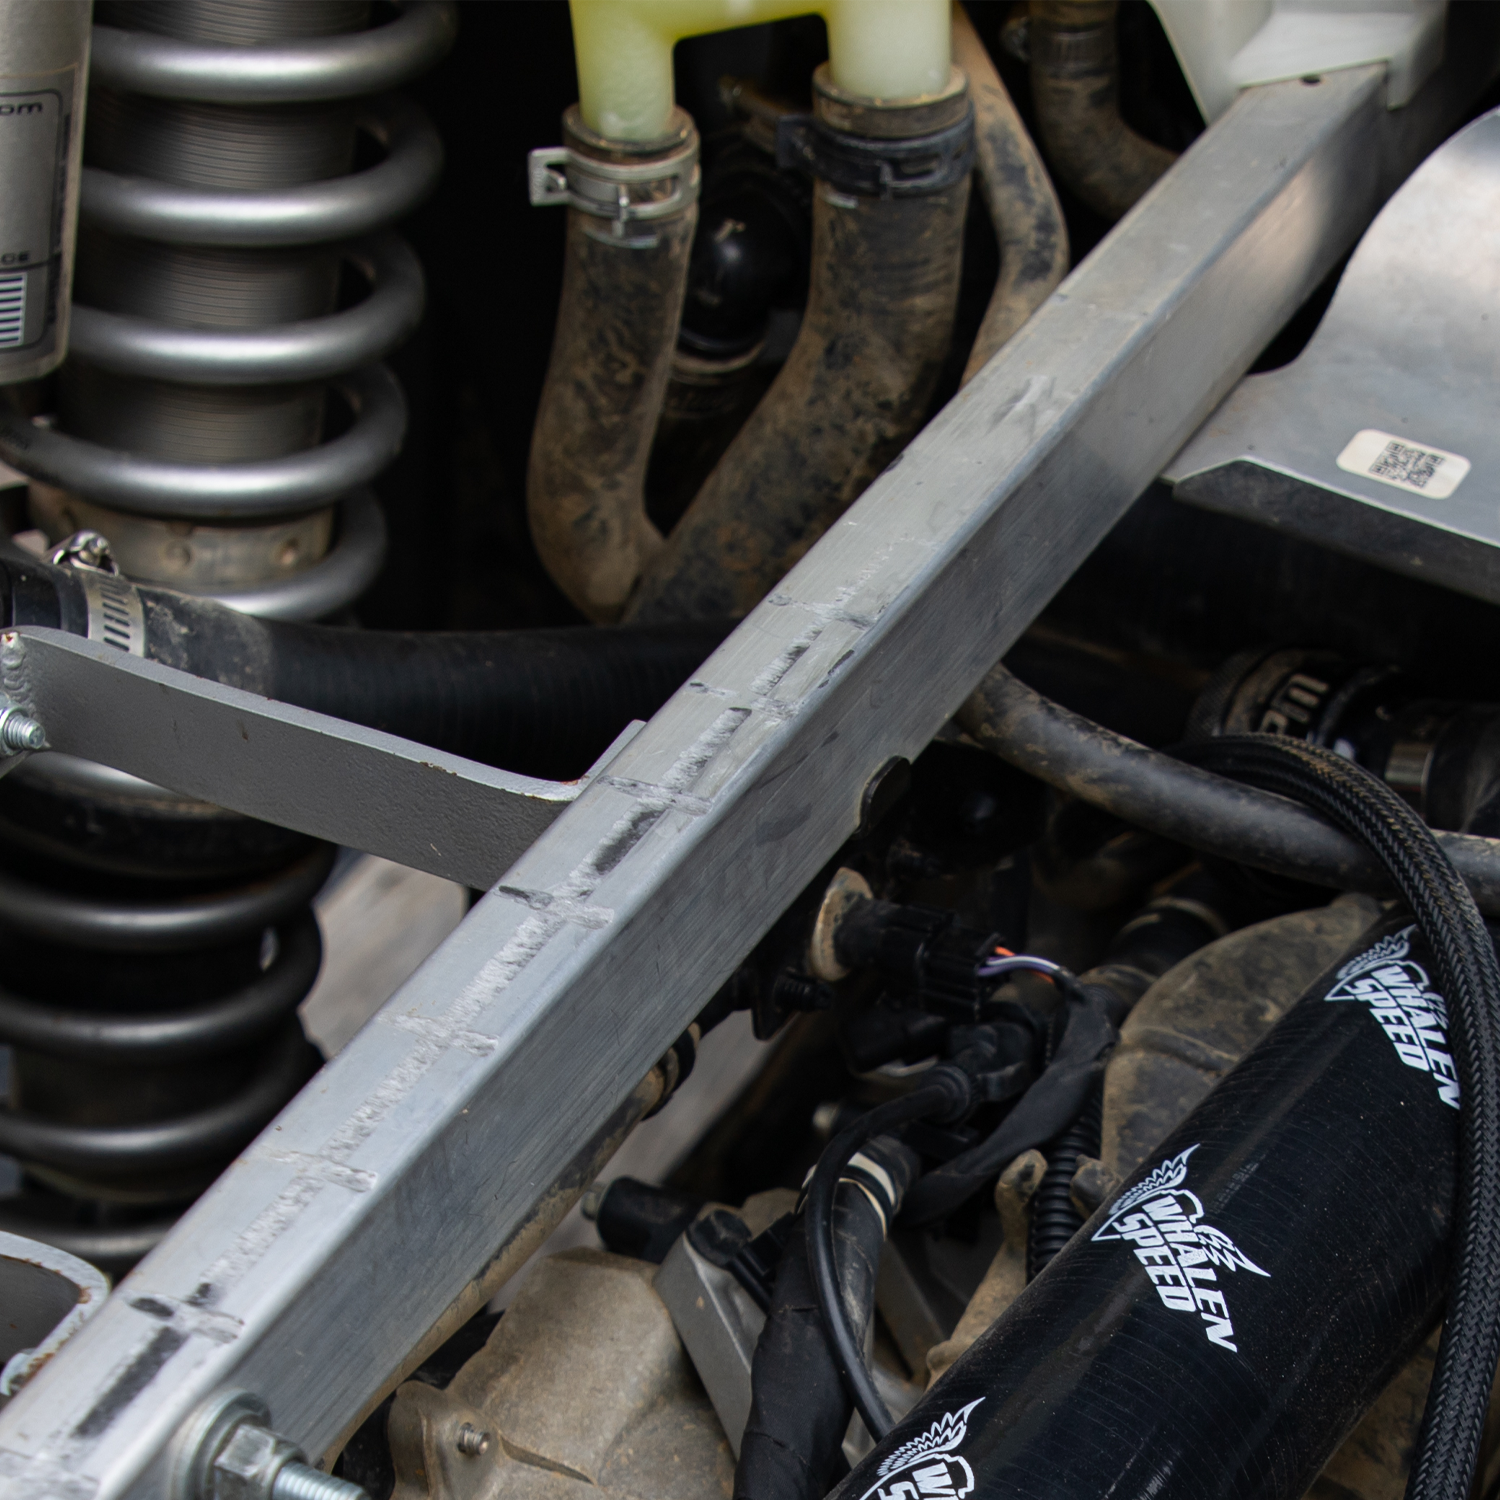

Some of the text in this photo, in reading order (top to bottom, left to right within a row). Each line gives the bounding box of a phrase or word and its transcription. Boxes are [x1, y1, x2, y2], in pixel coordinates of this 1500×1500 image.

[1343, 978, 1430, 1072] SPEED
[1371, 965, 1461, 1110] WHALEN
[1111, 1213, 1197, 1313] SPEED
[1141, 1194, 1238, 1353] WHALEN
